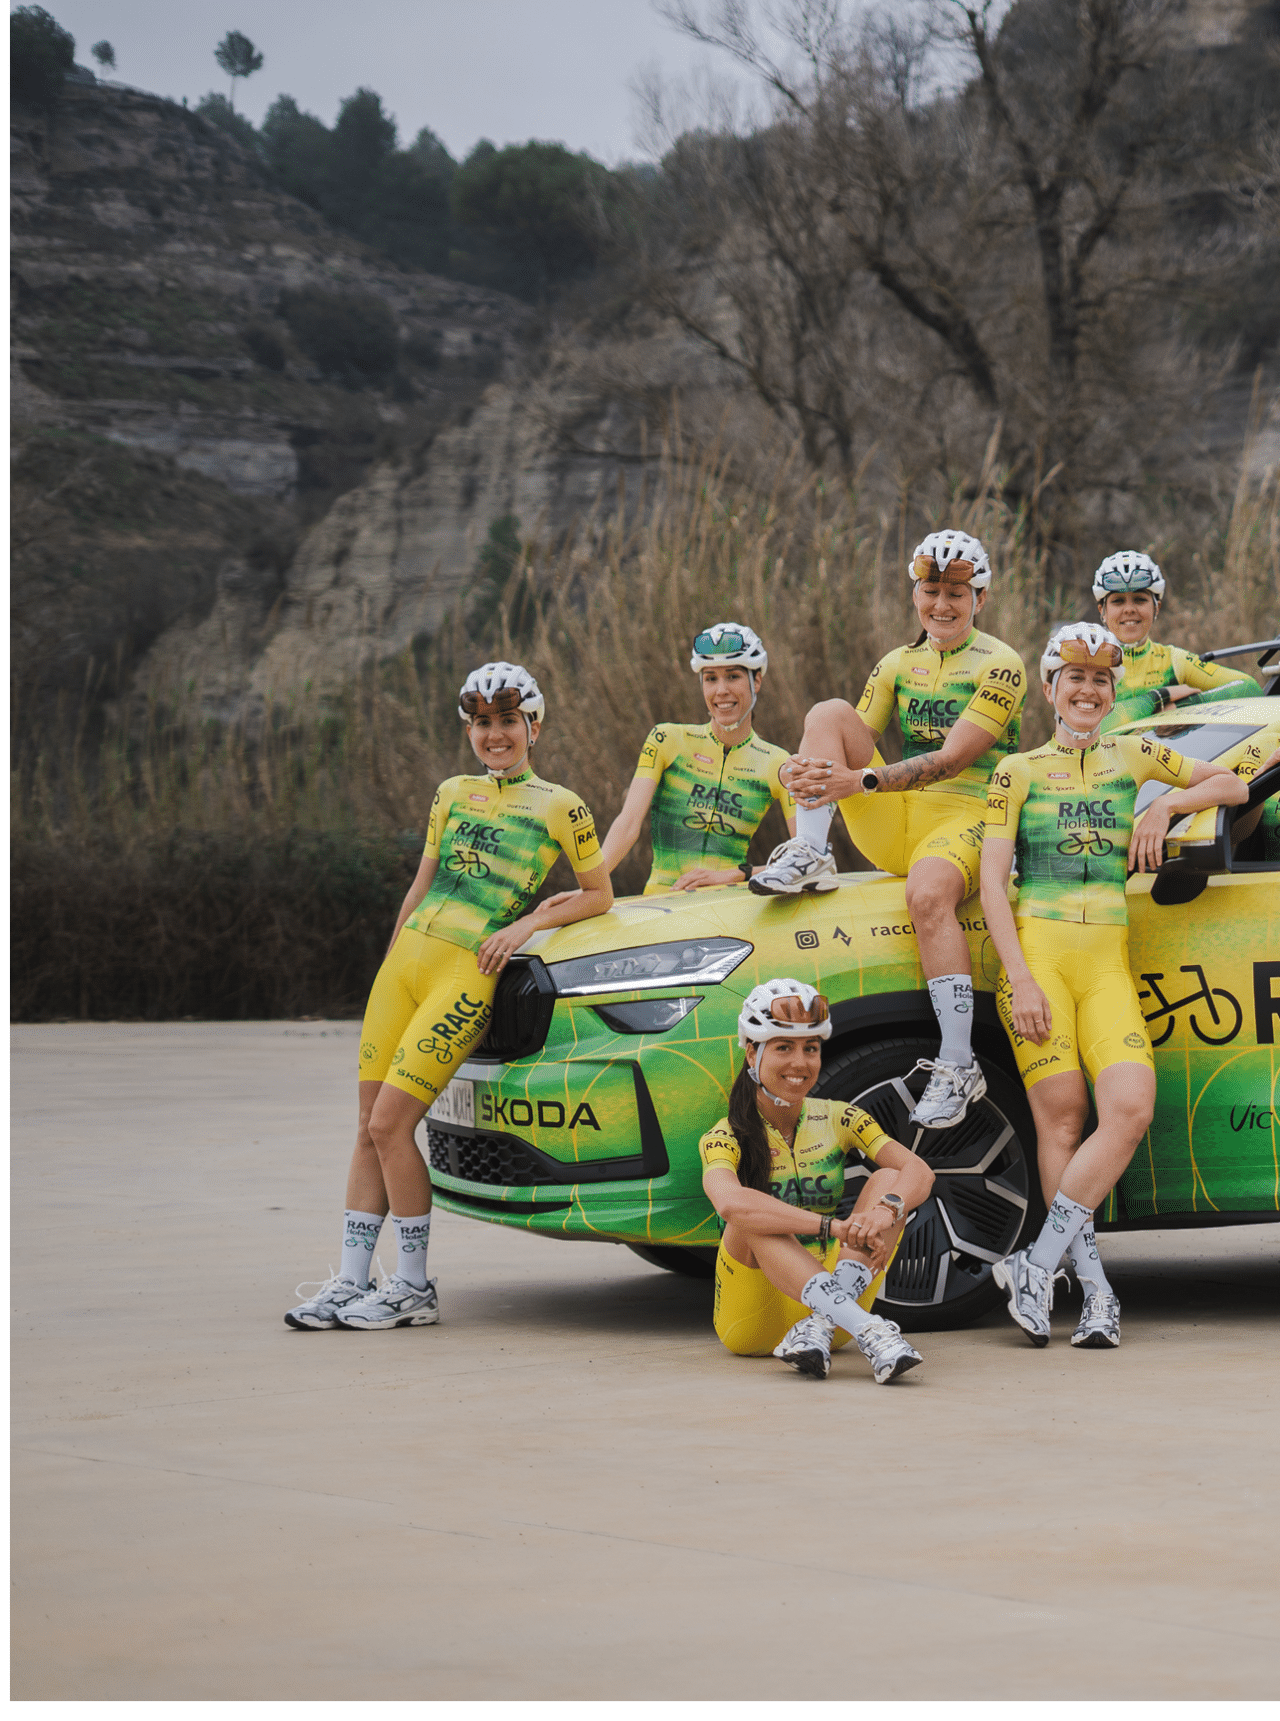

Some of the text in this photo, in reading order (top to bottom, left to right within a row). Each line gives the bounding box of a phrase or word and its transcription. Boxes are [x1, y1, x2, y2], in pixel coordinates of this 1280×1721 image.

[907, 698, 960, 716] RACC
[980, 689, 1012, 711] RACC
[905, 715, 959, 728] HolaBIC
[1056, 744, 1075, 755] RACC
[507, 774, 526, 785] RACC
[690, 783, 742, 808] RACC
[987, 798, 1005, 810] ACC
[1058, 799, 1116, 818] RACC
[455, 821, 505, 843] RACC
[431, 992, 484, 1041] RACC
[1229, 1099, 1273, 1133] Vic
[705, 1141, 738, 1153] RACC
[800, 1142, 824, 1154] QUETZAL
[769, 1174, 833, 1198] RACC
[347, 1220, 382, 1232] RACC
